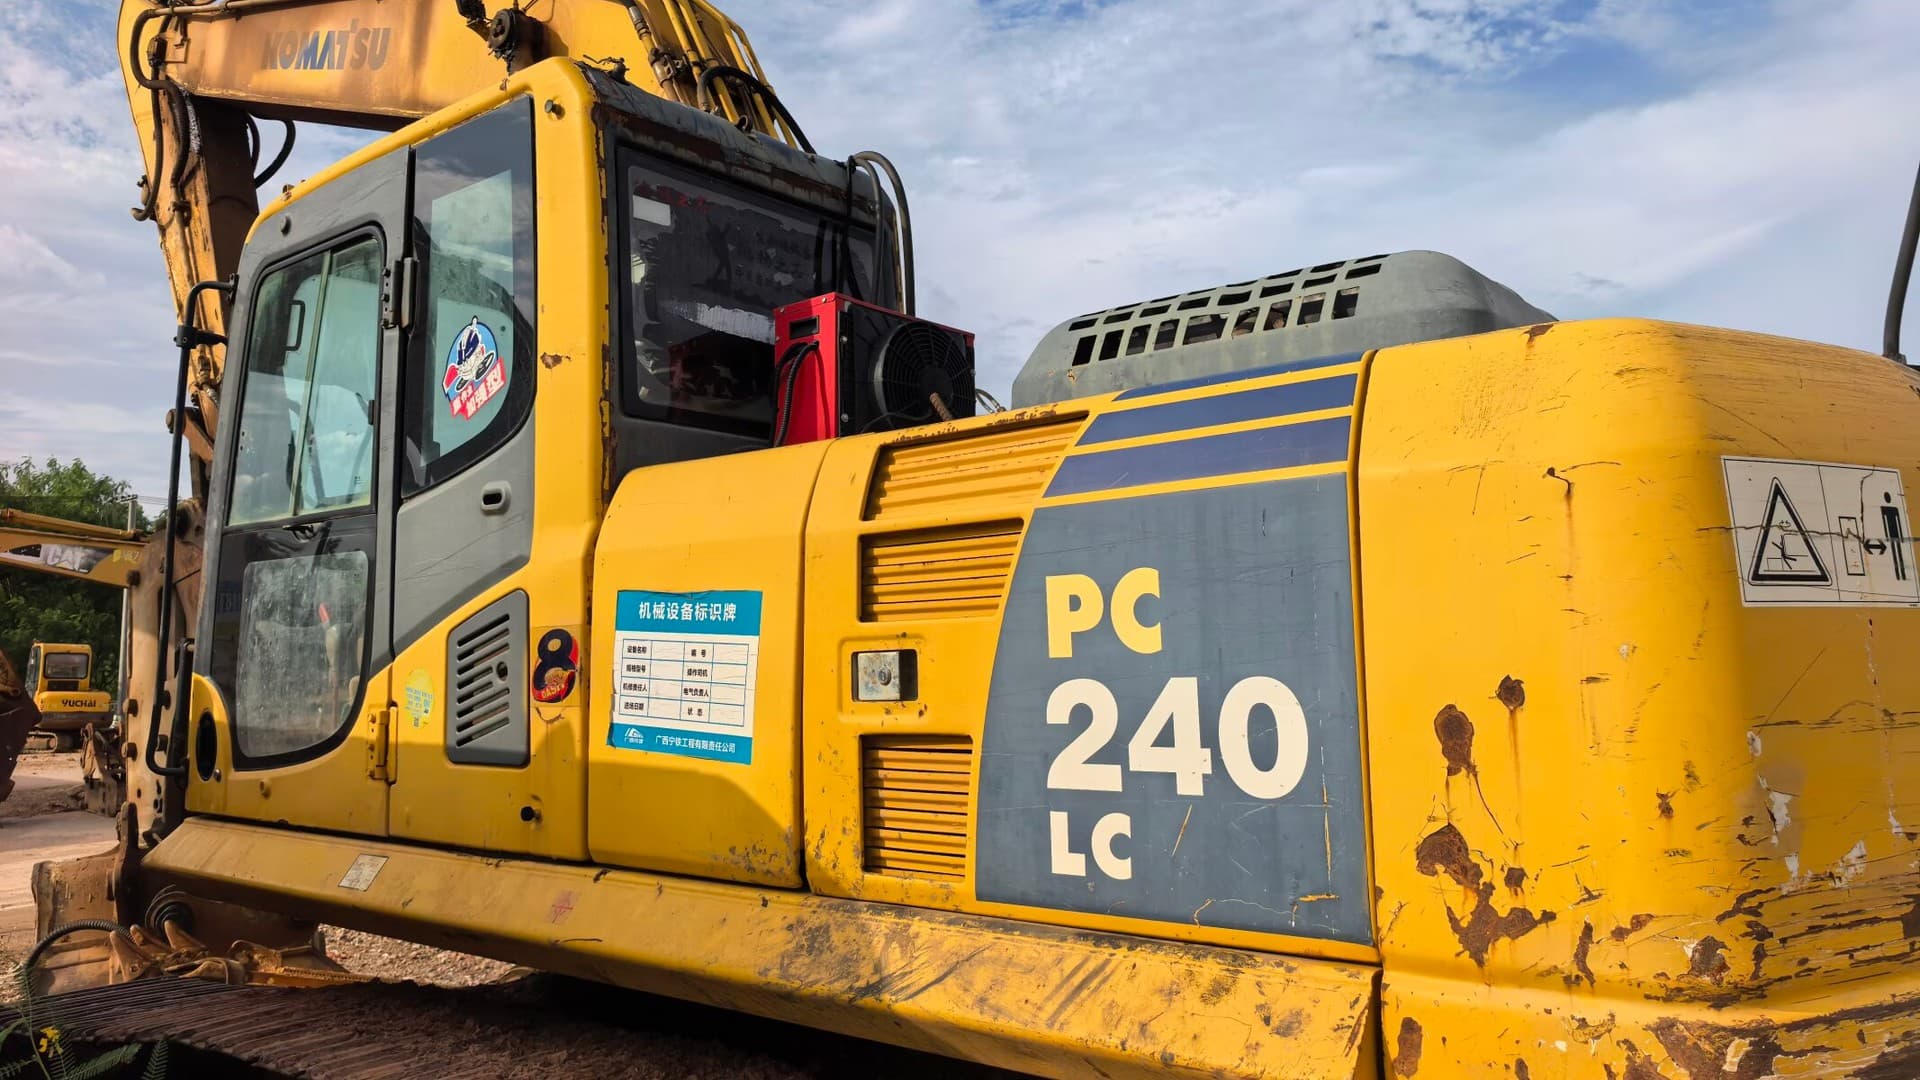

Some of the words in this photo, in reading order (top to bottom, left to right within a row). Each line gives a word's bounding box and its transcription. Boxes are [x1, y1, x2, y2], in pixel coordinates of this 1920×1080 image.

[260, 18, 392, 71] KOMATSU
[638, 601, 737, 622] 机械设备标识牌
[1045, 567, 1162, 658] PC
[1046, 676, 1308, 799] 240
[1050, 811, 1132, 880] LC
